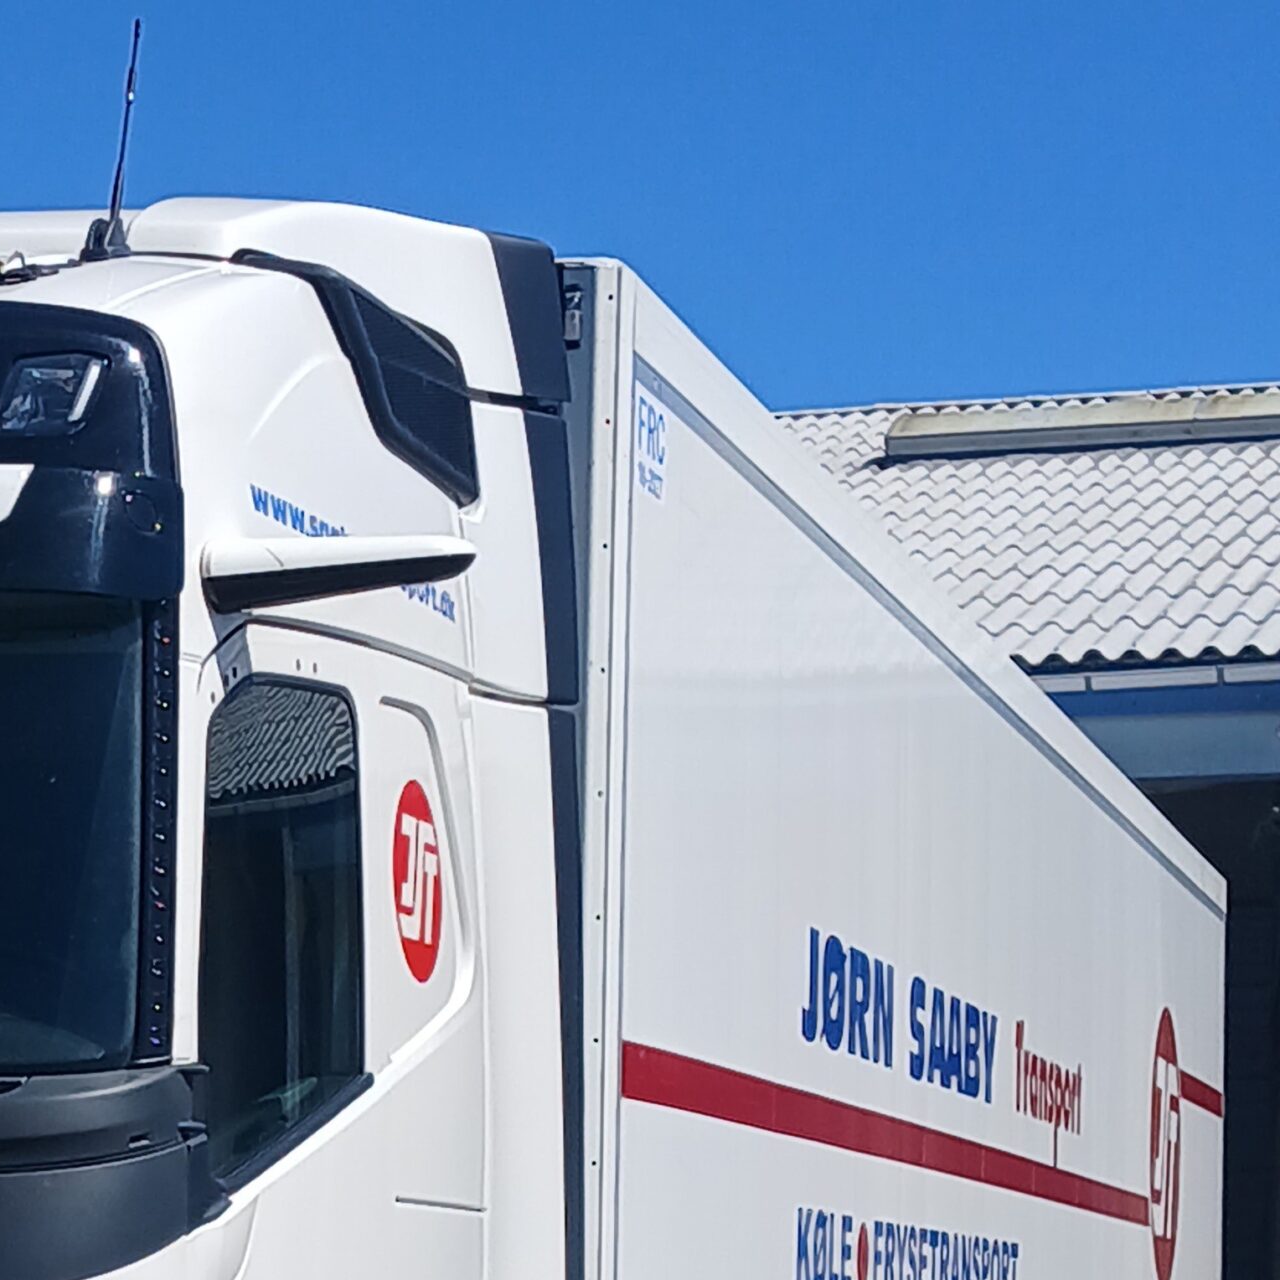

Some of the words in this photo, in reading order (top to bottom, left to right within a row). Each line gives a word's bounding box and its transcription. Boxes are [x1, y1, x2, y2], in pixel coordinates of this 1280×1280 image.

[638, 395, 666, 465] FRC
[802, 927, 895, 1068] JØRN
[909, 976, 998, 1104] SAABY
[1014, 1019, 1083, 1168] Transport
